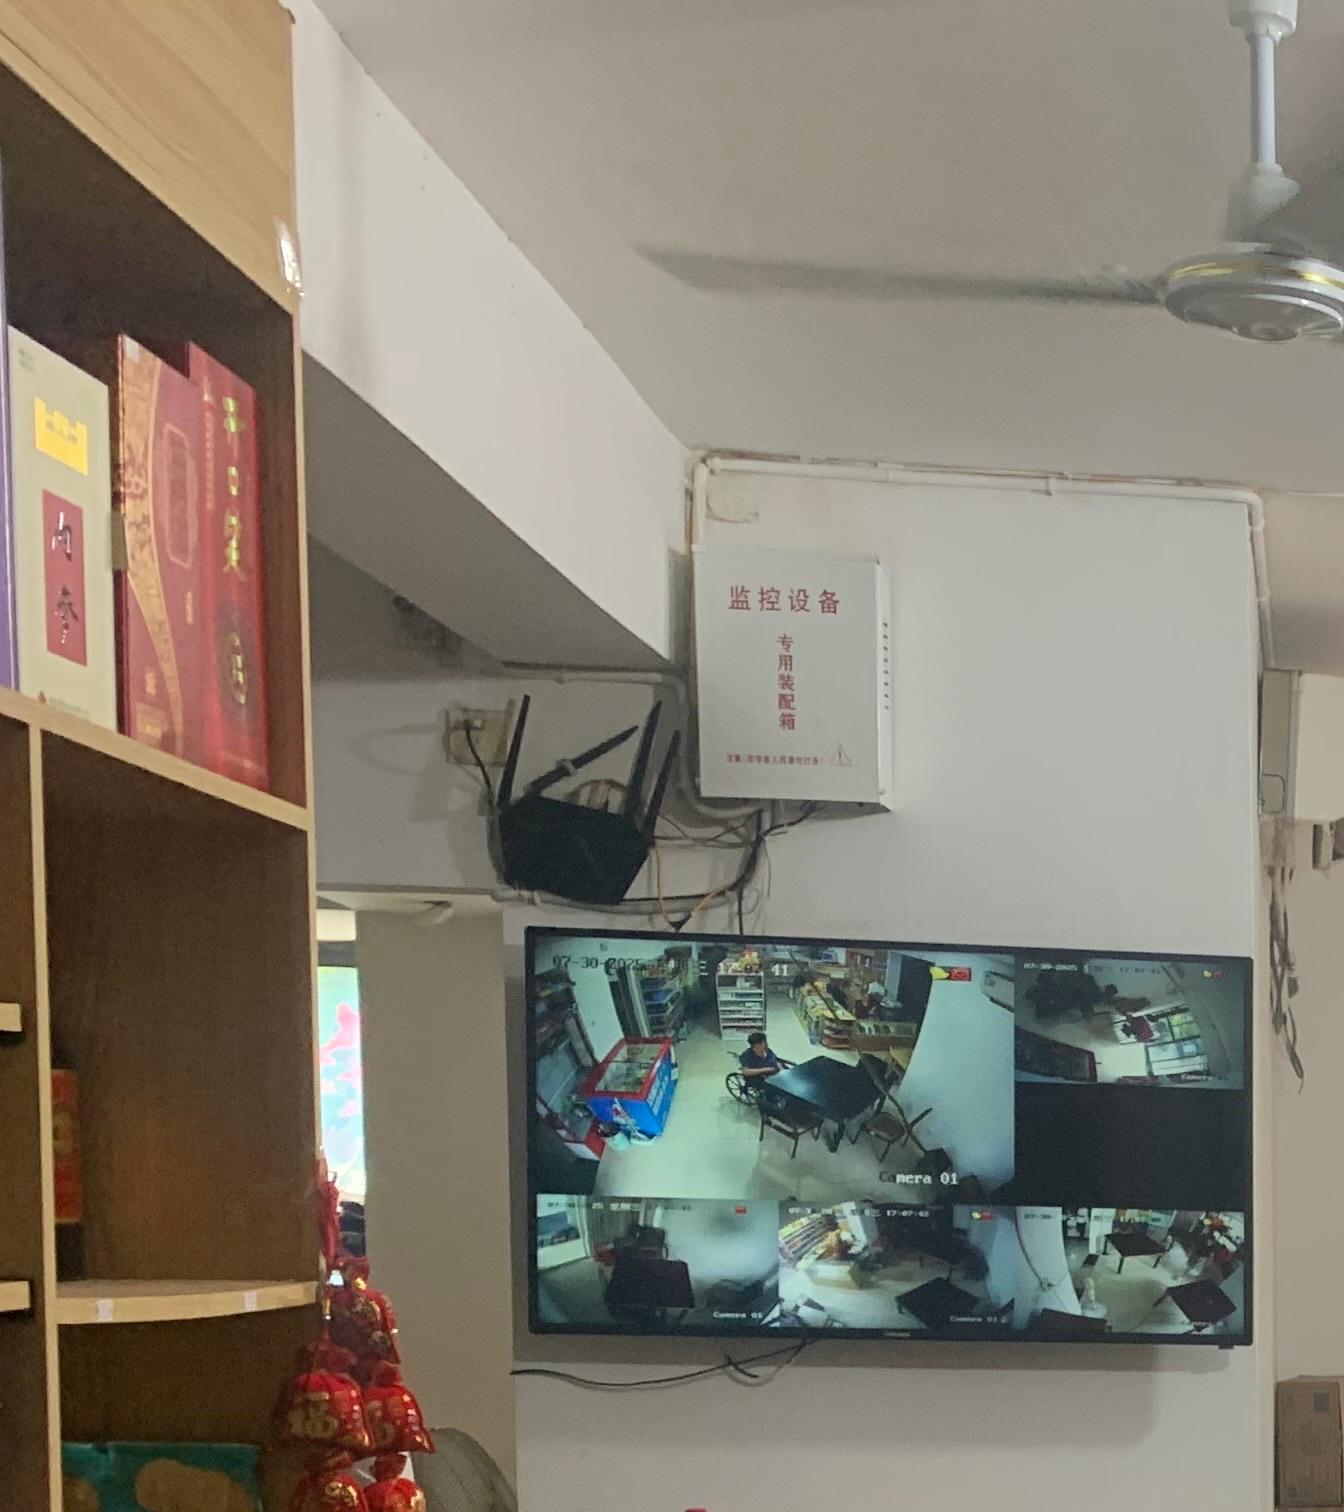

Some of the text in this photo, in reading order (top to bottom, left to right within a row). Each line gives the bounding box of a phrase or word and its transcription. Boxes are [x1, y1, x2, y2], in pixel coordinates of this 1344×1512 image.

[729, 585, 840, 615] 监控设备
[777, 633, 797, 731] 专用装配箱
